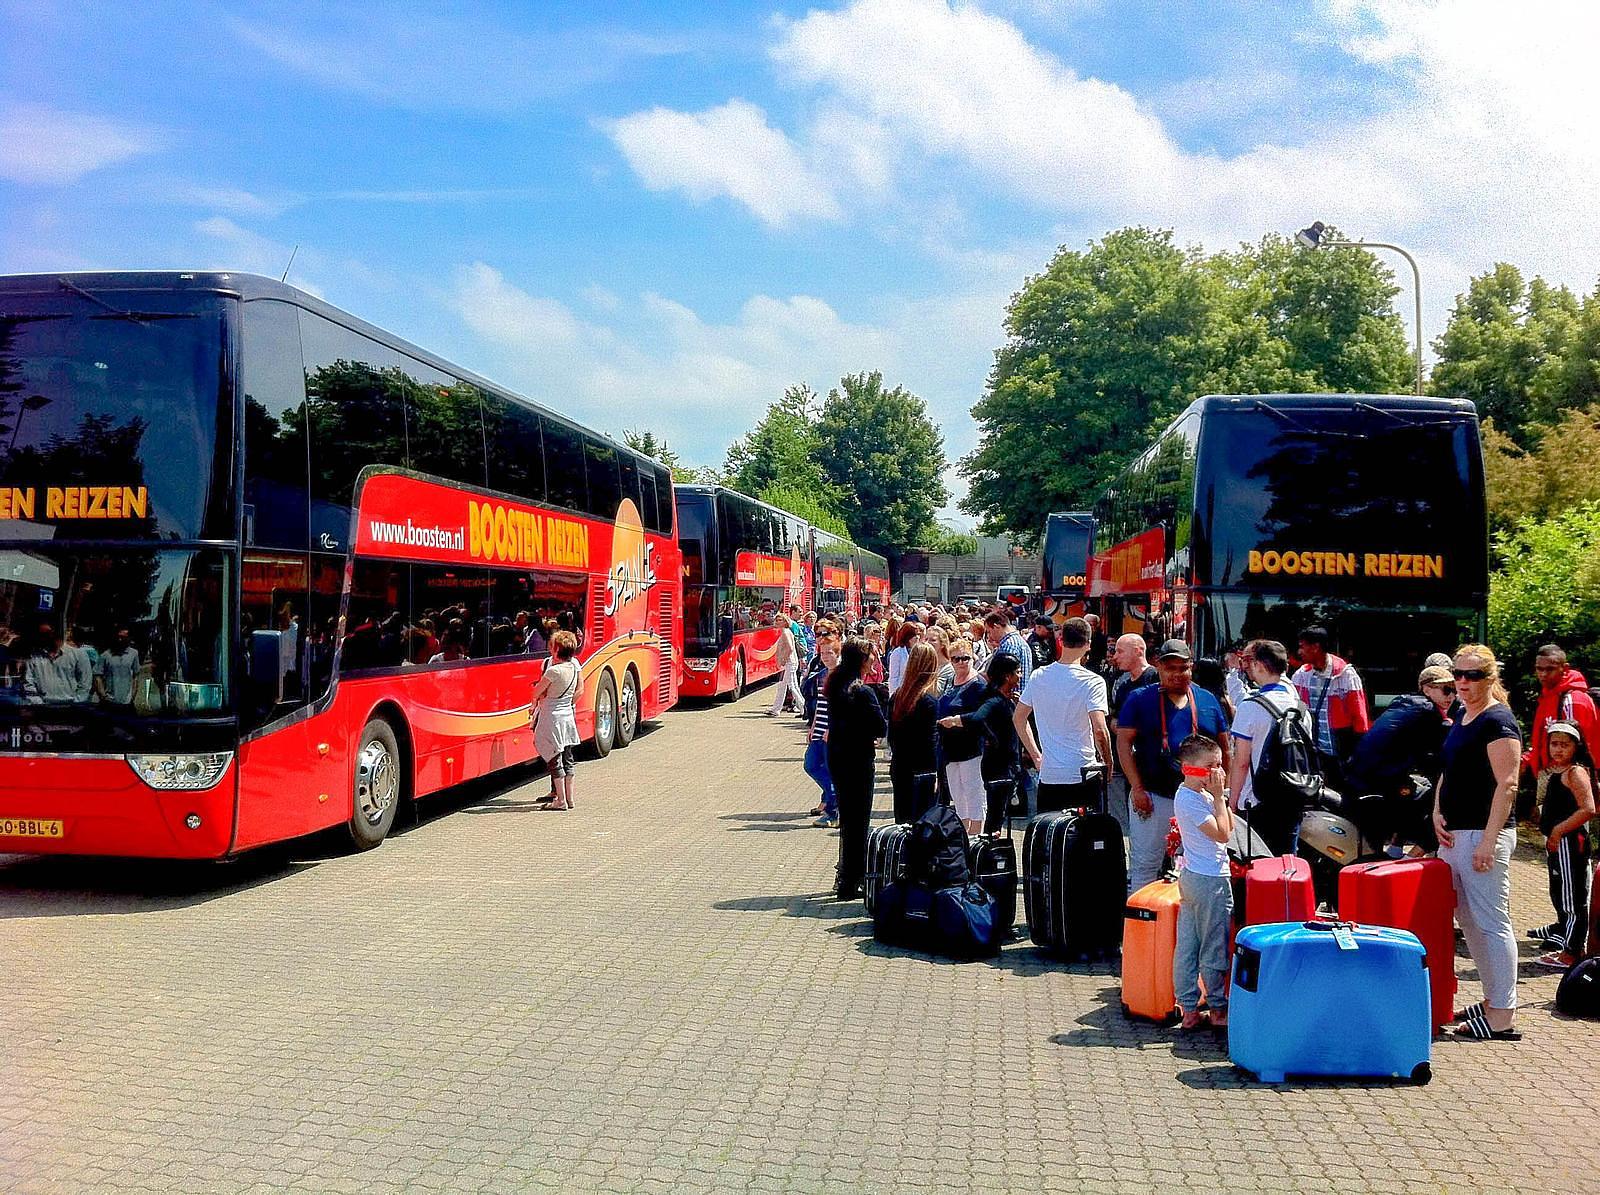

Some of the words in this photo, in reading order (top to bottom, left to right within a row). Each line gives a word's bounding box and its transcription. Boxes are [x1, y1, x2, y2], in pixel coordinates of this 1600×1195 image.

[46, 486, 147, 518] REIZEN
[370, 519, 464, 550] www.boosten.nl
[469, 500, 543, 565] BOOSTEN
[547, 516, 589, 568] REIZEN
[1249, 550, 1355, 575] BOOSTEN
[1364, 553, 1443, 578] REIZEN
